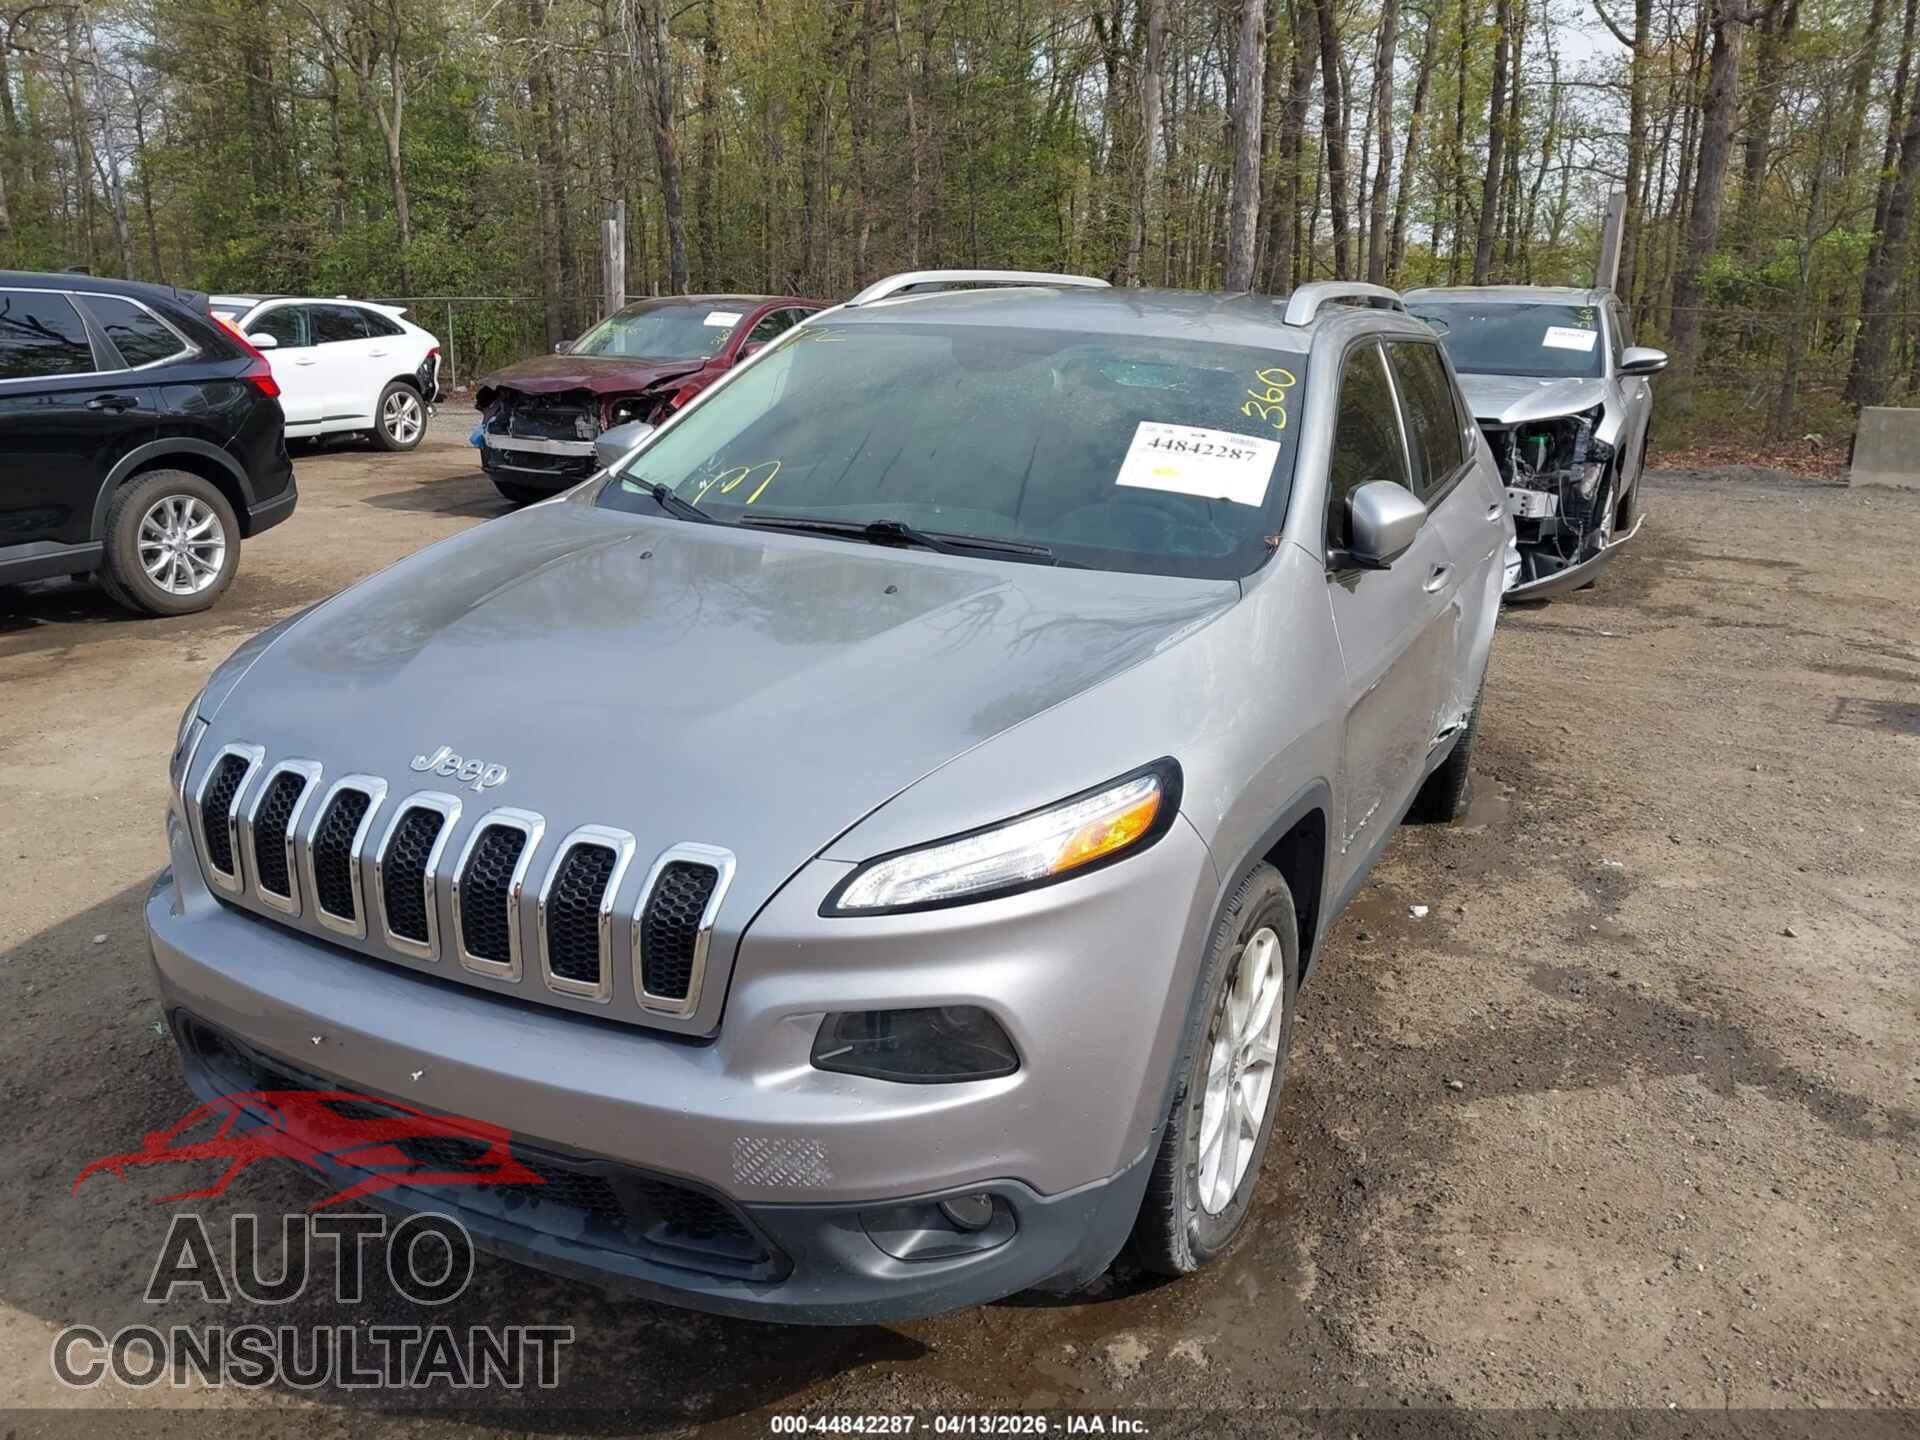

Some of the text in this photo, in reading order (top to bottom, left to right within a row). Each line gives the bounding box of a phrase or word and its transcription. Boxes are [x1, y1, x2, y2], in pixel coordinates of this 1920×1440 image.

[1241, 368, 1296, 430] 360
[1147, 437, 1257, 462] 44842287
[409, 745, 508, 794] Jeep
